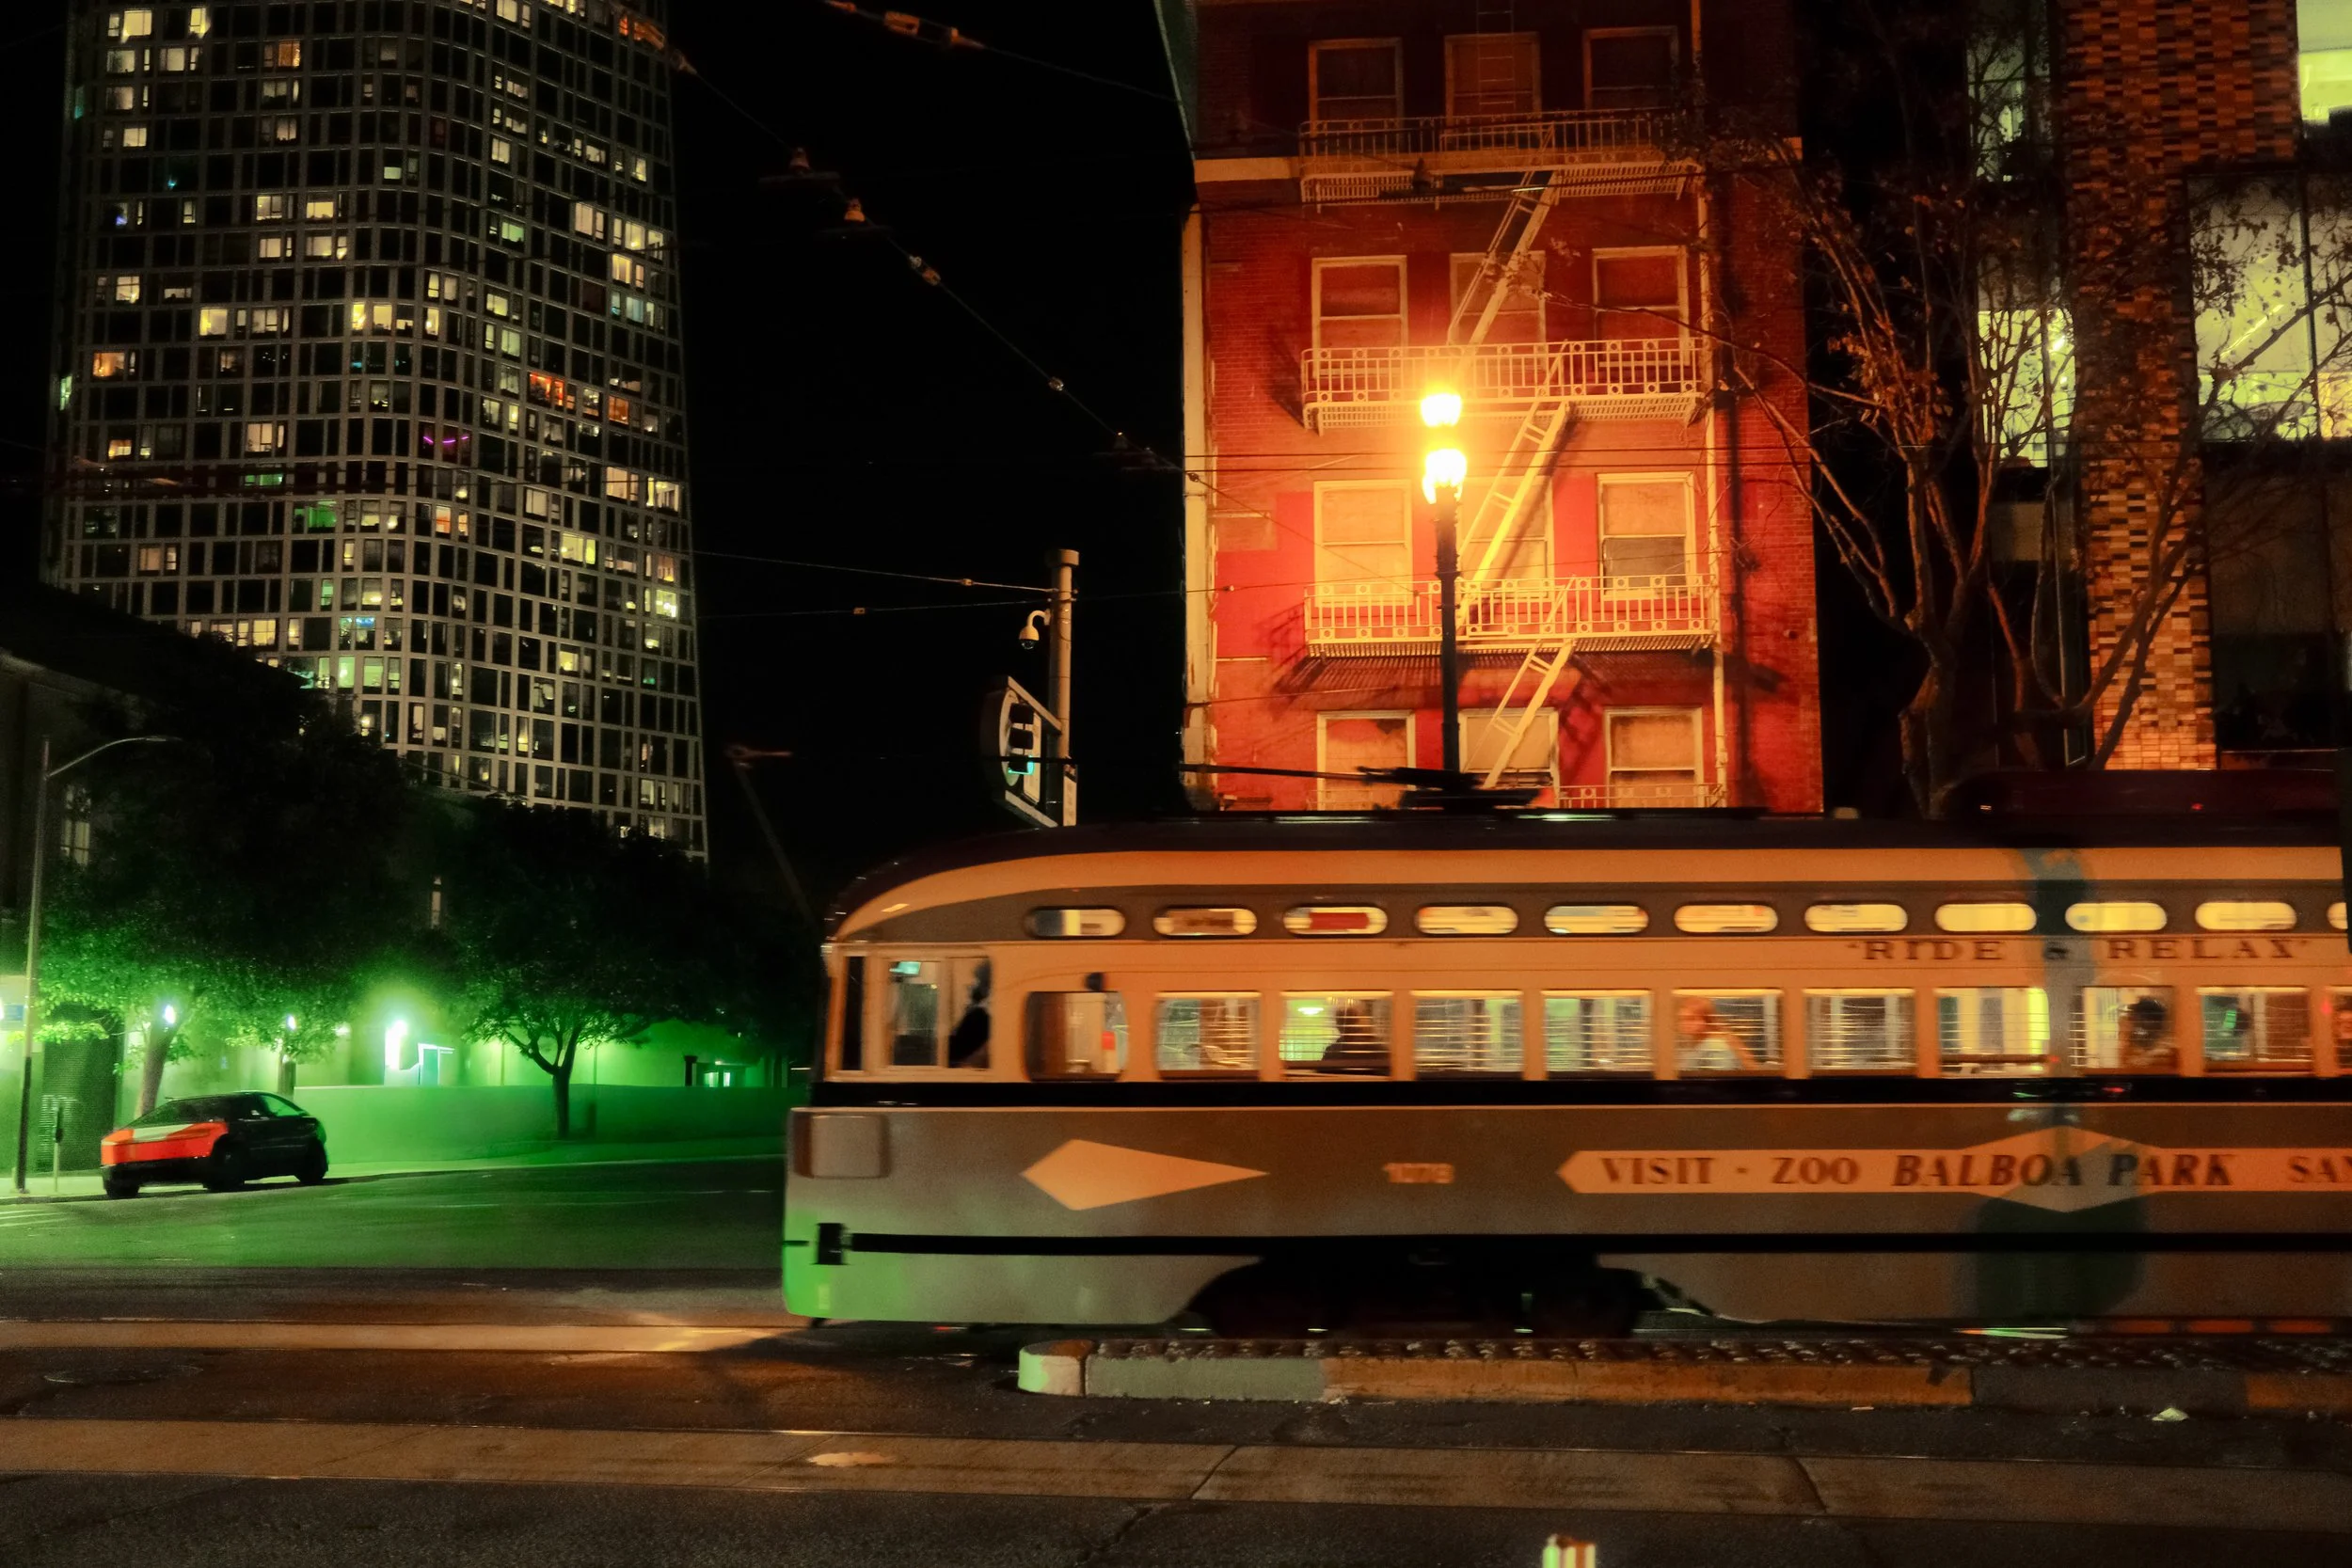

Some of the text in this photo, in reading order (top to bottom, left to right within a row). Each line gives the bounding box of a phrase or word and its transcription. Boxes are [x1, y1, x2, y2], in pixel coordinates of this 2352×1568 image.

[1601, 1157, 1716, 1184] VISIT
[1771, 1156, 1862, 1184] ZOO
[1890, 1154, 2082, 1186] BALBOA
[2107, 1154, 2235, 1186] PARK
